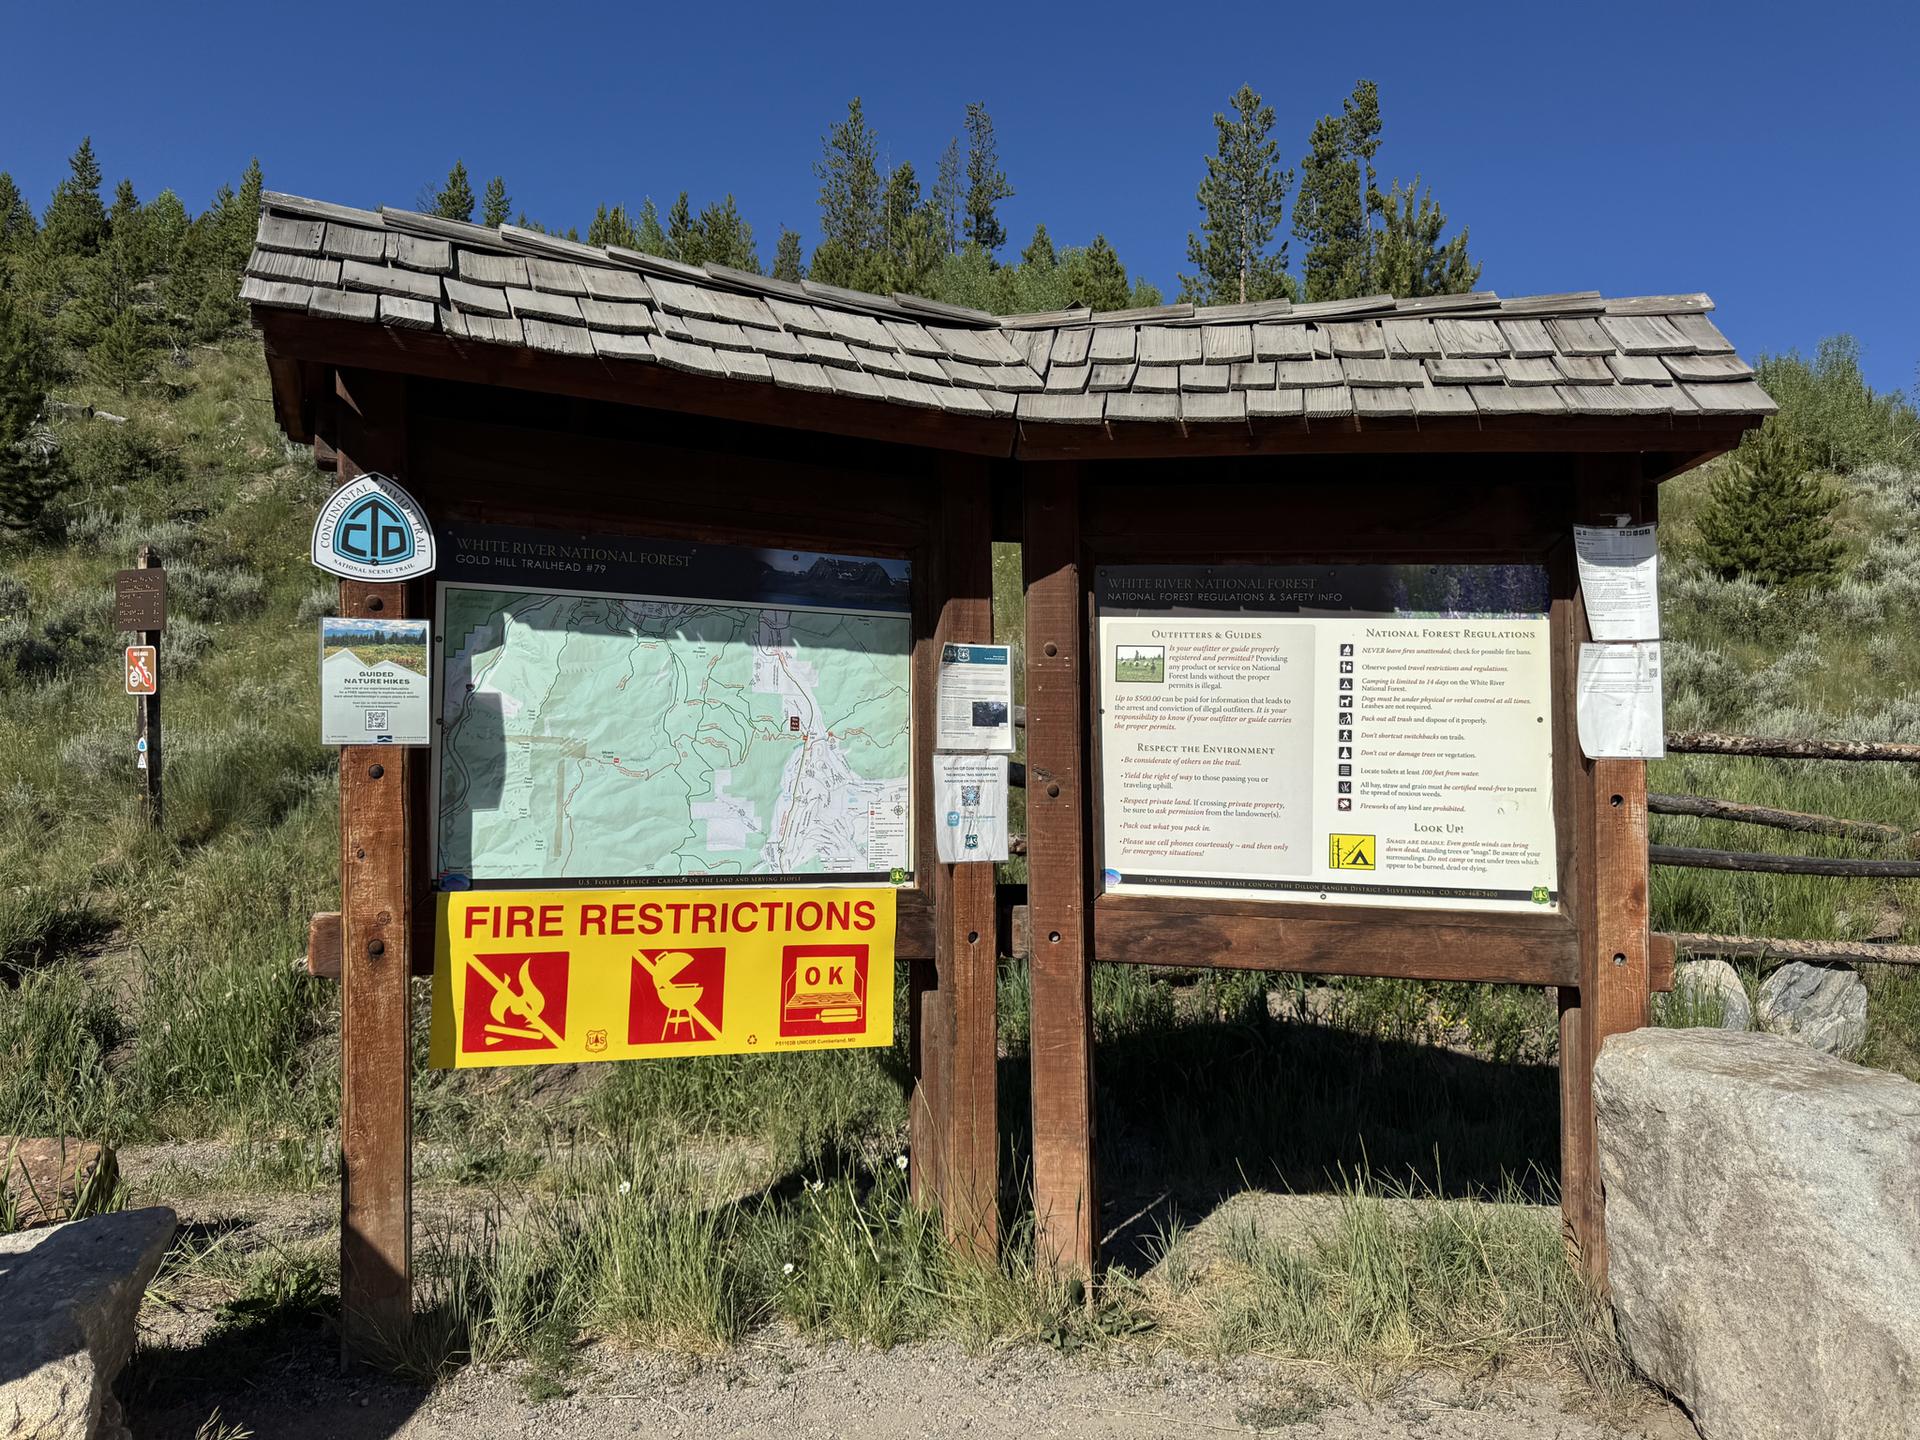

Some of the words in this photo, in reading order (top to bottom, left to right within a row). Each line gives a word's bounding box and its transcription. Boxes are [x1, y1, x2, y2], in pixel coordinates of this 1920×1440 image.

[321, 483, 371, 548] CONTINENTAL
[379, 484, 415, 518] DIVIDE
[413, 519, 426, 556] TRAIL
[456, 537, 509, 552] WHITE
[513, 541, 557, 556] RIVER
[560, 544, 637, 563] NATIONAL
[640, 552, 690, 566] FOREST
[334, 559, 366, 574] NATIONAL
[395, 564, 415, 573] TRAIL
[456, 554, 490, 565] GOLD
[495, 556, 518, 568] HILL
[521, 558, 581, 572] TRAILHEAD
[586, 564, 606, 574] #79
[1108, 578, 1152, 588] WHITE
[1155, 578, 1192, 589] RIVER
[1194, 578, 1264, 589] NATIONAL
[1268, 578, 1317, 589] FOREST
[1107, 593, 1156, 601] NATIONAL
[1160, 593, 1194, 601] FOREST
[1198, 593, 1265, 601] REGULATIONS
[1269, 593, 1276, 601] &
[1280, 593, 1314, 601] SAFETY
[1318, 593, 1343, 602] INFO
[1214, 631, 1222, 639] &
[1192, 644, 1220, 653] outfitter
[1229, 644, 1249, 654] guide
[1250, 645, 1280, 654] properly
[1168, 653, 1201, 662] registered
[1202, 653, 1216, 661] and
[1255, 654, 1288, 663] Providing
[1181, 663, 1207, 672] product
[1386, 664, 1407, 672] posted
[1425, 716, 1447, 724] dispose
[1123, 755, 1132, 763] Be
[1133, 756, 1171, 764] considerate
[1172, 757, 1180, 766] of
[1123, 796, 1148, 806] Respect
[1148, 798, 1173, 806] private
[1199, 799, 1227, 808] crossing
[1227, 800, 1252, 809] private
[1152, 822, 1170, 830] what
[1184, 823, 1200, 833] pack
[1322, 884, 1348, 892] RANGER
[1350, 886, 1381, 894] DISTRICT
[464, 904, 564, 939] FIRE
[579, 900, 877, 936] RESTRICTIONS
[805, 965, 844, 986] OK
